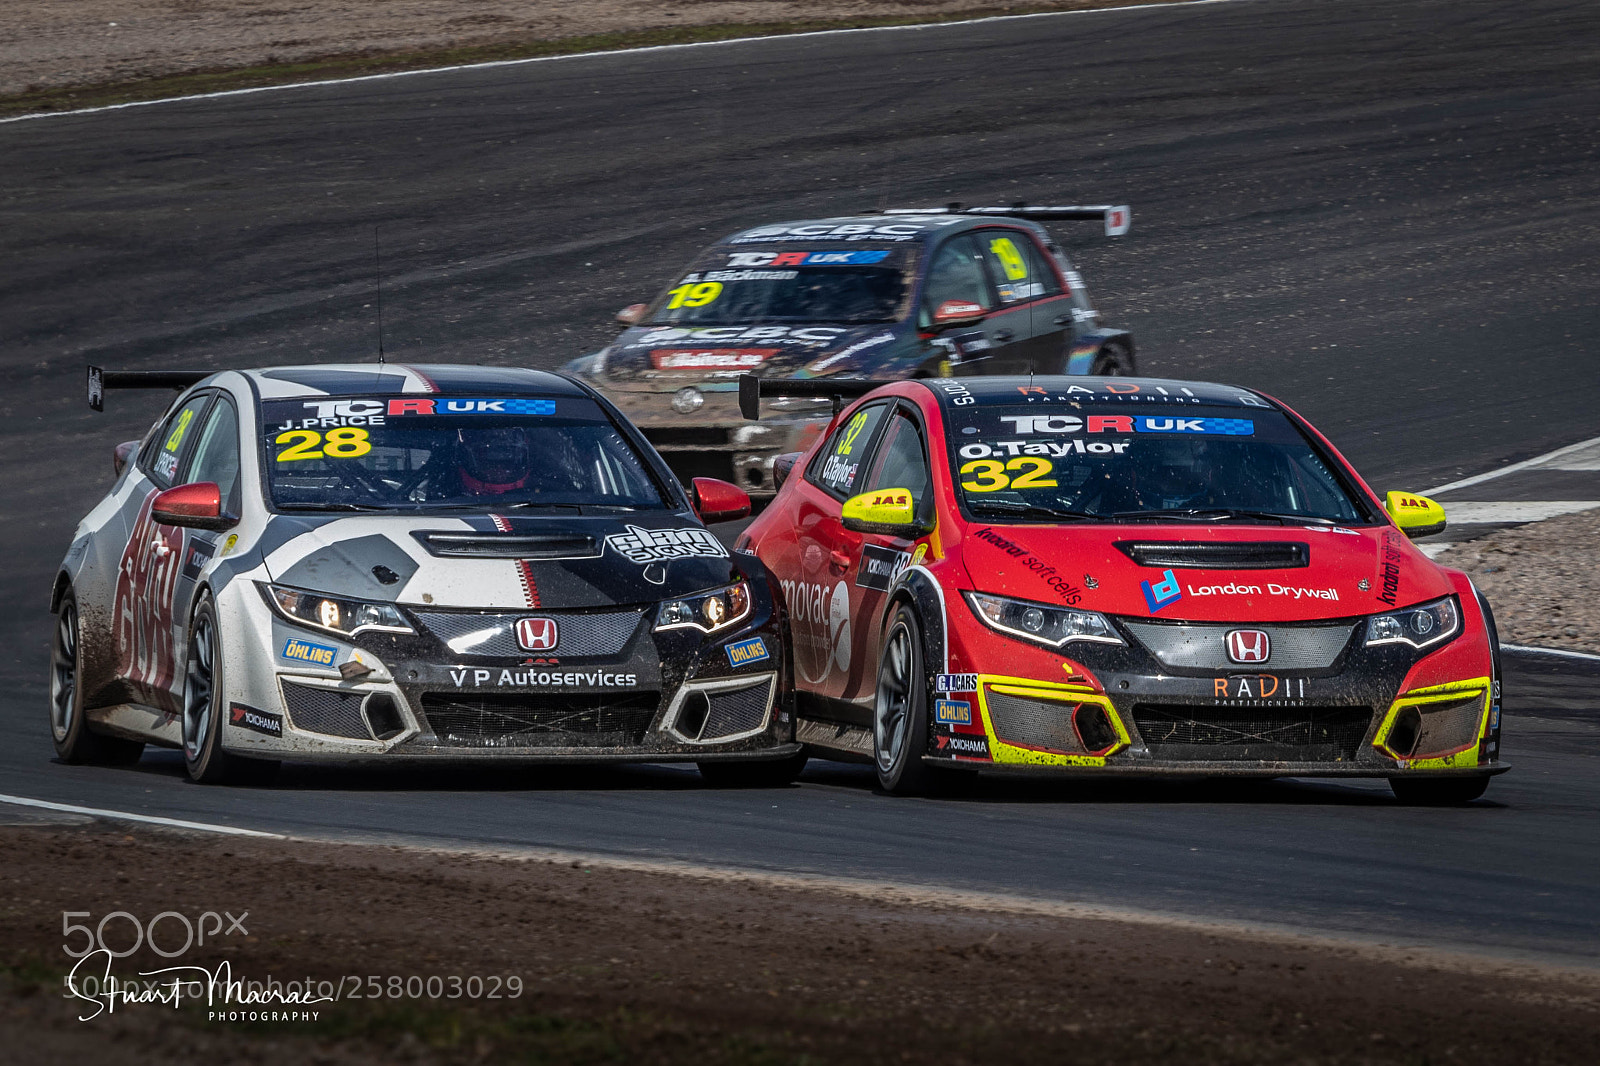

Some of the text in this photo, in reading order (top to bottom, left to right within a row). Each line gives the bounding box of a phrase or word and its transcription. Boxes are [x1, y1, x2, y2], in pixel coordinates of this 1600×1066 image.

[727, 252, 855, 266] TCR UK
[666, 282, 723, 309] 19
[1017, 381, 1194, 397] RADII
[303, 399, 506, 418] TCR UK
[278, 415, 385, 431] J.PRICE
[1000, 415, 1205, 434] TCR UK
[837, 412, 868, 455] 32
[275, 427, 371, 462] 28
[959, 440, 1130, 459] O.Taylor
[960, 456, 1058, 493] 32
[872, 496, 907, 505] JAS
[1401, 498, 1429, 508] JAS
[1187, 583, 1339, 601] London Drywall
[1376, 562, 1400, 606] kvadrat
[450, 668, 637, 687] V P Autoservices
[1214, 674, 1305, 698] RADII
[245, 712, 280, 732] YOKOHAMA
[949, 738, 987, 753] YOKOHAMA
